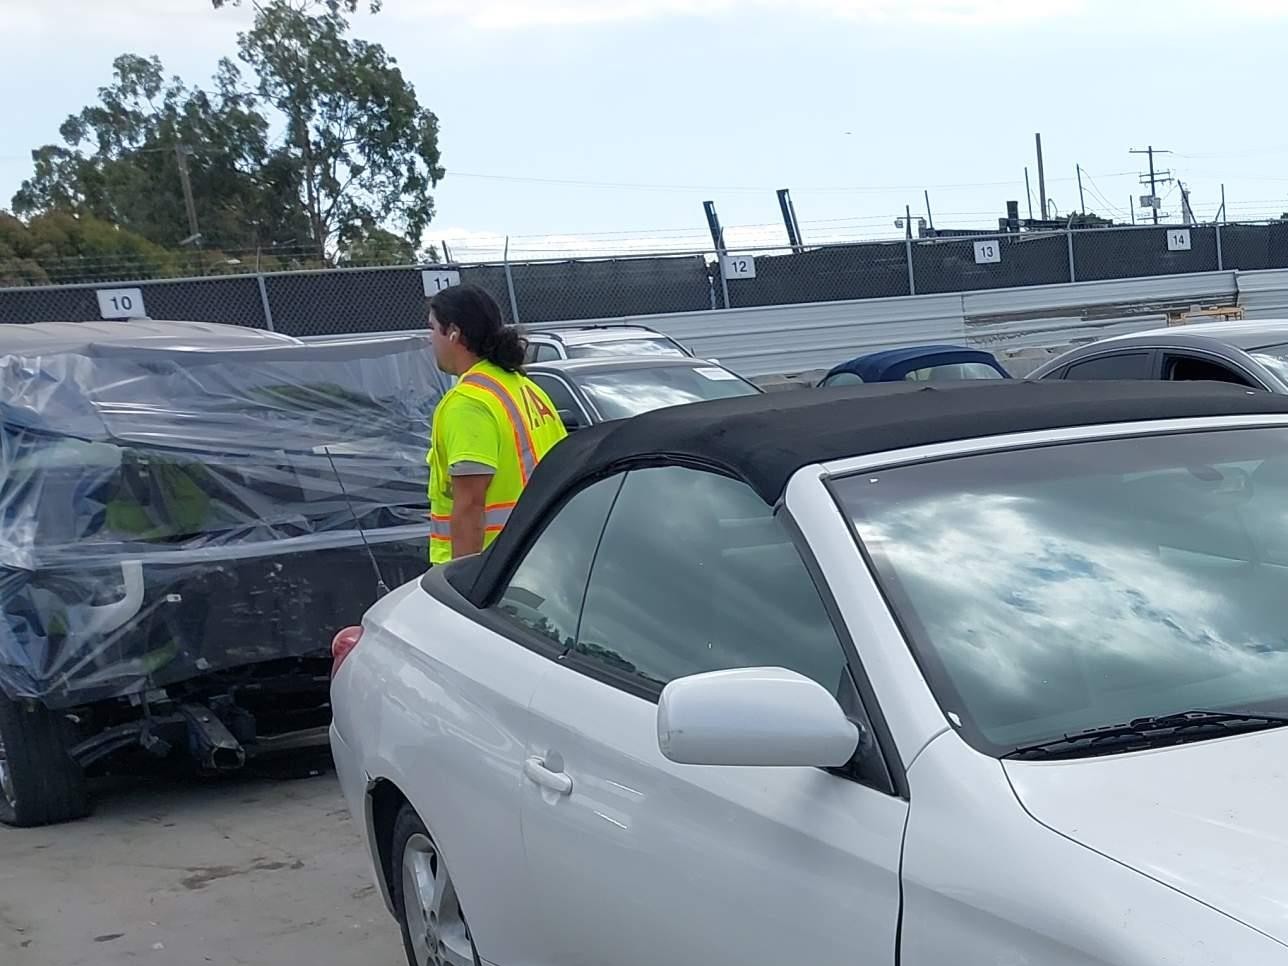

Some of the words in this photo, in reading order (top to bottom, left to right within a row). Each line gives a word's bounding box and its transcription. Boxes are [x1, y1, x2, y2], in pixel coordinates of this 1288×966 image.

[1173, 234, 1185, 246] 14
[980, 246, 993, 258] 13
[732, 261, 747, 273] 12
[433, 277, 451, 291] 11
[109, 295, 133, 311] 10
